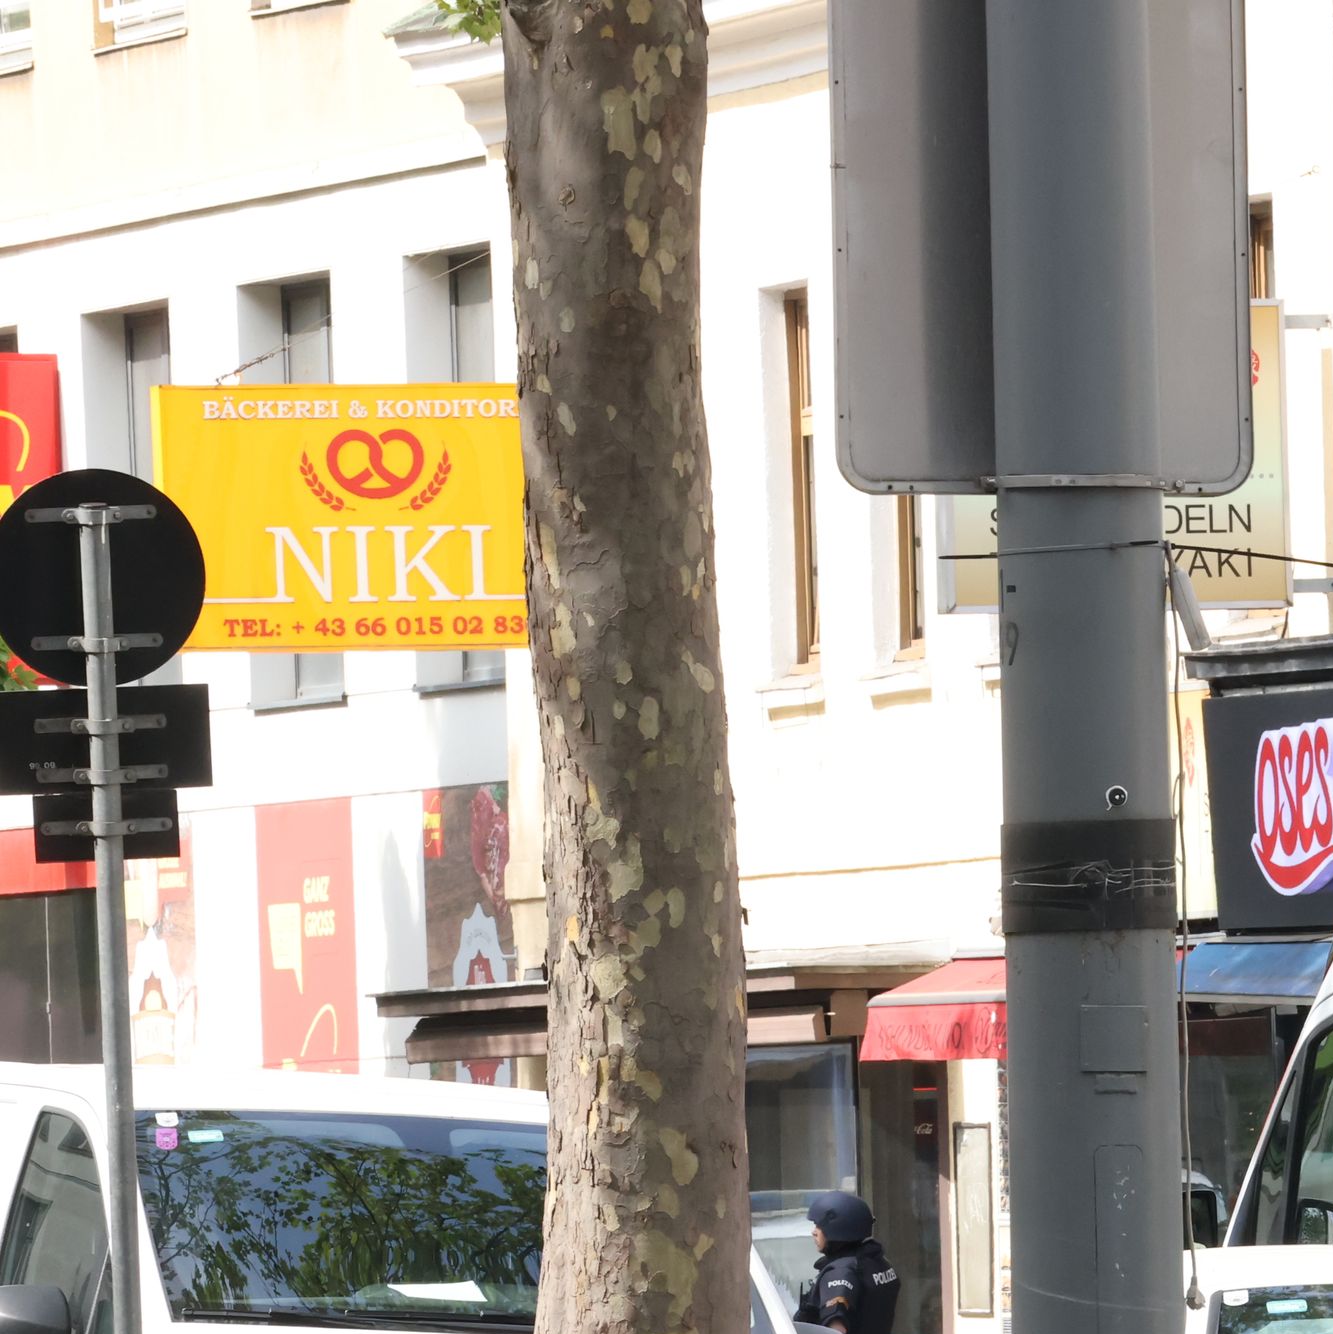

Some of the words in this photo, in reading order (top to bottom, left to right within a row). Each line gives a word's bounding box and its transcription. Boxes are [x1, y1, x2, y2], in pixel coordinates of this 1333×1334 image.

[202, 397, 339, 420] BÄCKEREI
[348, 400, 369, 419] &
[264, 524, 492, 604] NIKI
[223, 619, 281, 638] TEL:
[315, 618, 346, 637] 43
[355, 617, 387, 636] 66
[396, 616, 444, 636] 015
[453, 615, 484, 636] 02
[494, 615, 529, 634] 83
